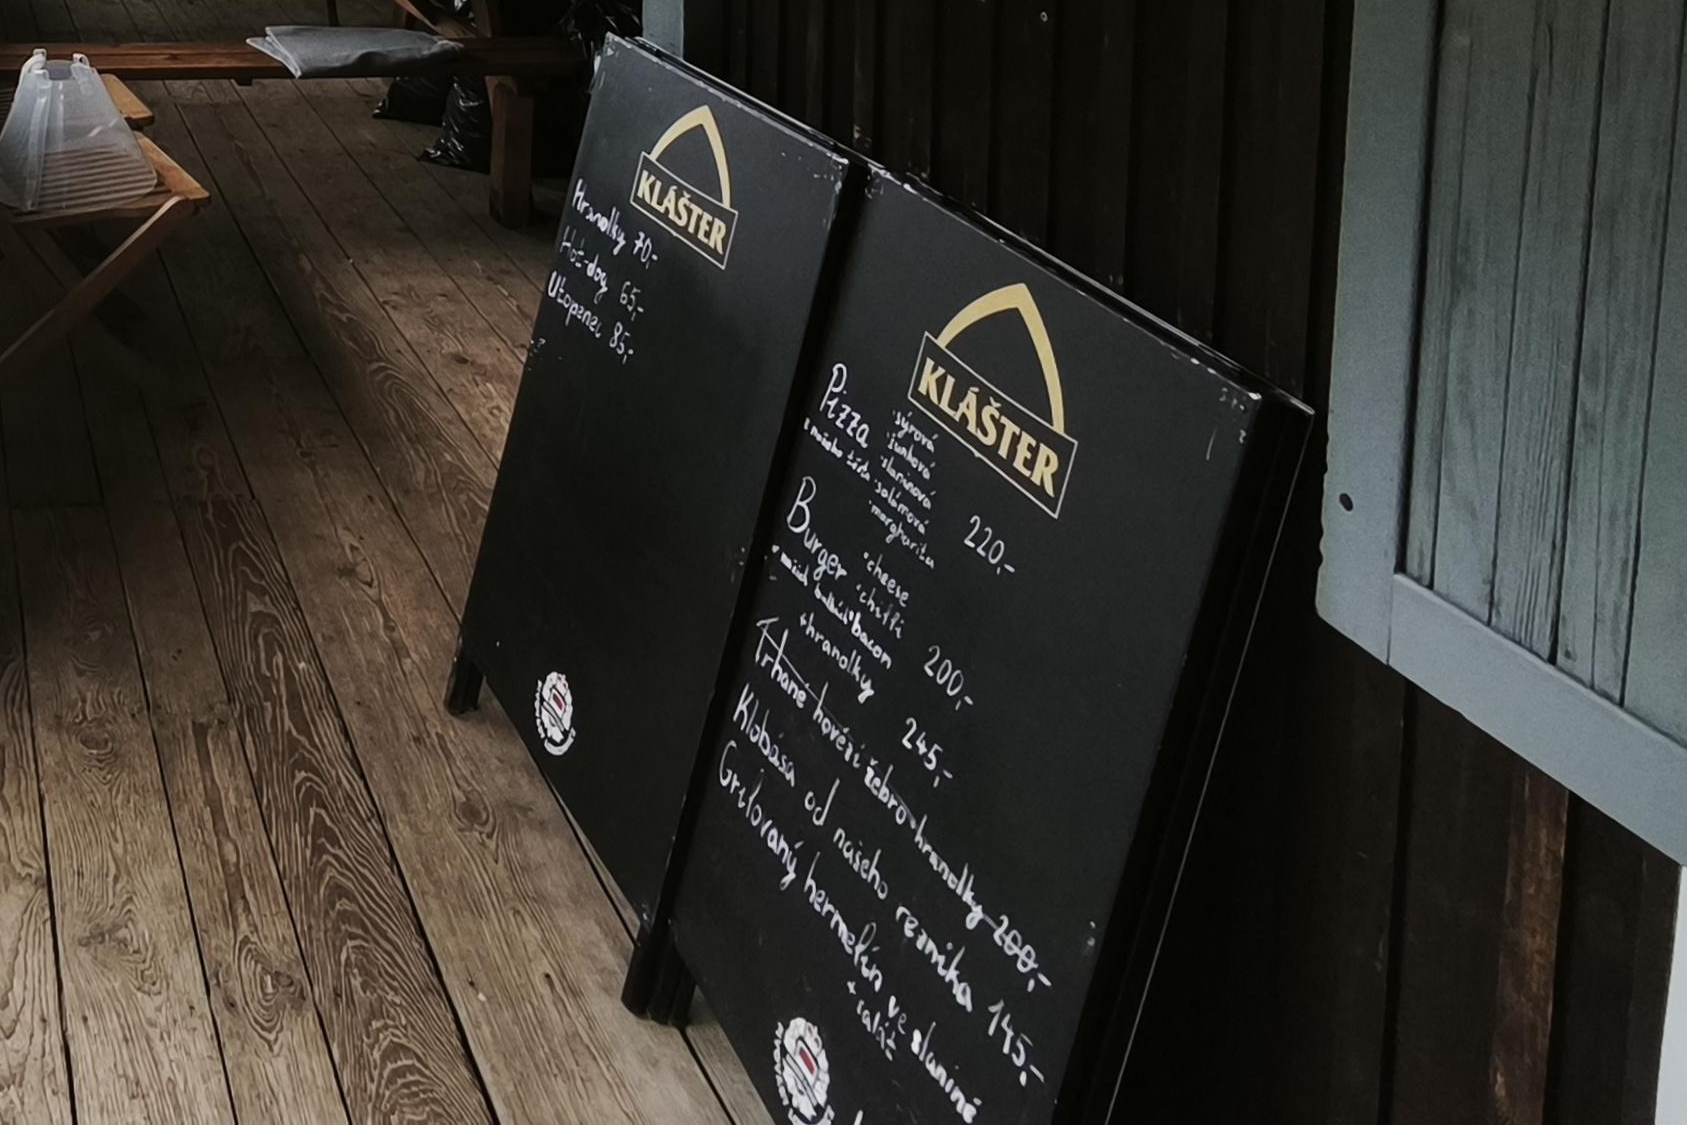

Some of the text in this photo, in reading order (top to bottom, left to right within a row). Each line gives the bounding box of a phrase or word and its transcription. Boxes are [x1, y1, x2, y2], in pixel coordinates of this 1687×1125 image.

[637, 170, 726, 254] KLÁŠTER
[819, 363, 869, 448] Pizza
[918, 357, 1059, 498] KLÁŠTER
[787, 476, 847, 581] Burger
[851, 612, 891, 669] bacon
[804, 778, 840, 826] od
[888, 995, 907, 1034] ve
